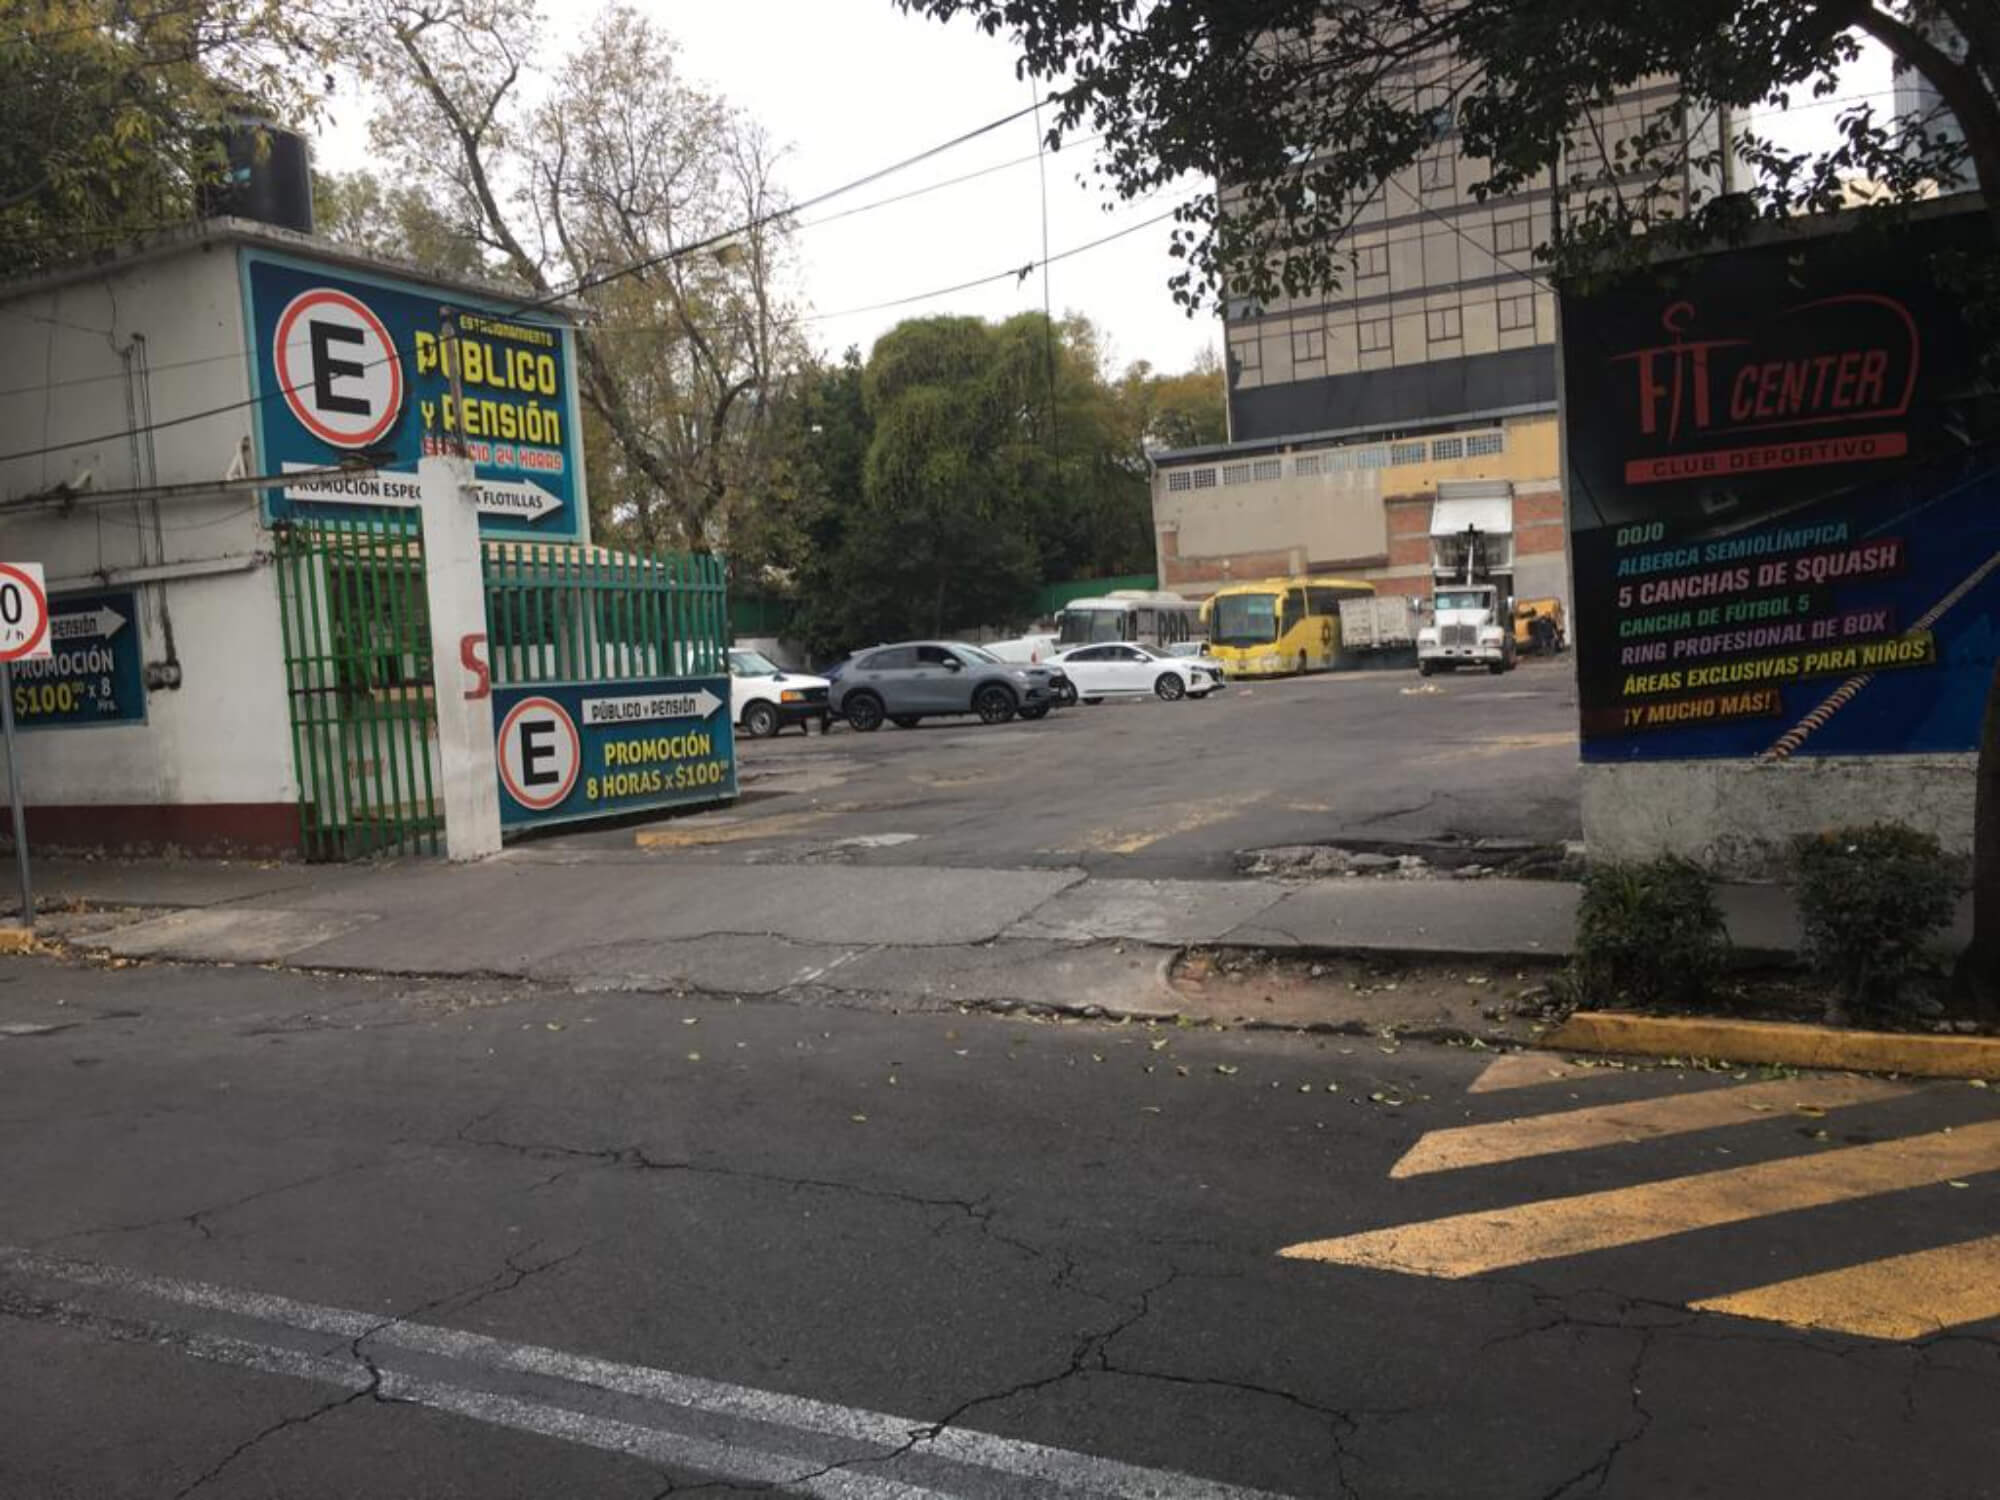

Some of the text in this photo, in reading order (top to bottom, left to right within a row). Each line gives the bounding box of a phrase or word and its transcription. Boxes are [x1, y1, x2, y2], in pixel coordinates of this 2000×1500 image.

[309, 319, 371, 416] E
[1612, 325, 1889, 445] FIT CENTER
[420, 394, 561, 445] Y PENSIÓN
[1653, 439, 1877, 478] CLUB DEPORTIVO
[483, 490, 543, 509] FLOTILLAS
[1616, 521, 1665, 548] DOJO
[1617, 521, 1849, 578] ALBERCA SEMIOLÍMPICA
[1617, 544, 1898, 609] 5 CANCHAS DE SQUASH
[1619, 610, 1692, 638] CANCHA
[1697, 607, 1720, 627] DE
[1799, 594, 1811, 613] 5
[1621, 610, 1888, 666] RING PROFESIONAL DE BOX
[11, 643, 115, 680] PROMOCIÓN
[1687, 655, 1799, 688] EXCLUSIVAS
[1804, 647, 1858, 673] PARA
[1862, 639, 1928, 666] NIÑOS
[101, 676, 112, 698] 8
[592, 701, 642, 721] PÚBLICO
[651, 696, 697, 716] PENSIÓN
[1624, 705, 1643, 728] ¡Y
[1648, 697, 1716, 724] MUCHO
[519, 720, 559, 787] E
[604, 729, 712, 768] PROMOCIÓN
[586, 777, 599, 800] 8
[603, 768, 661, 798] HORAS
